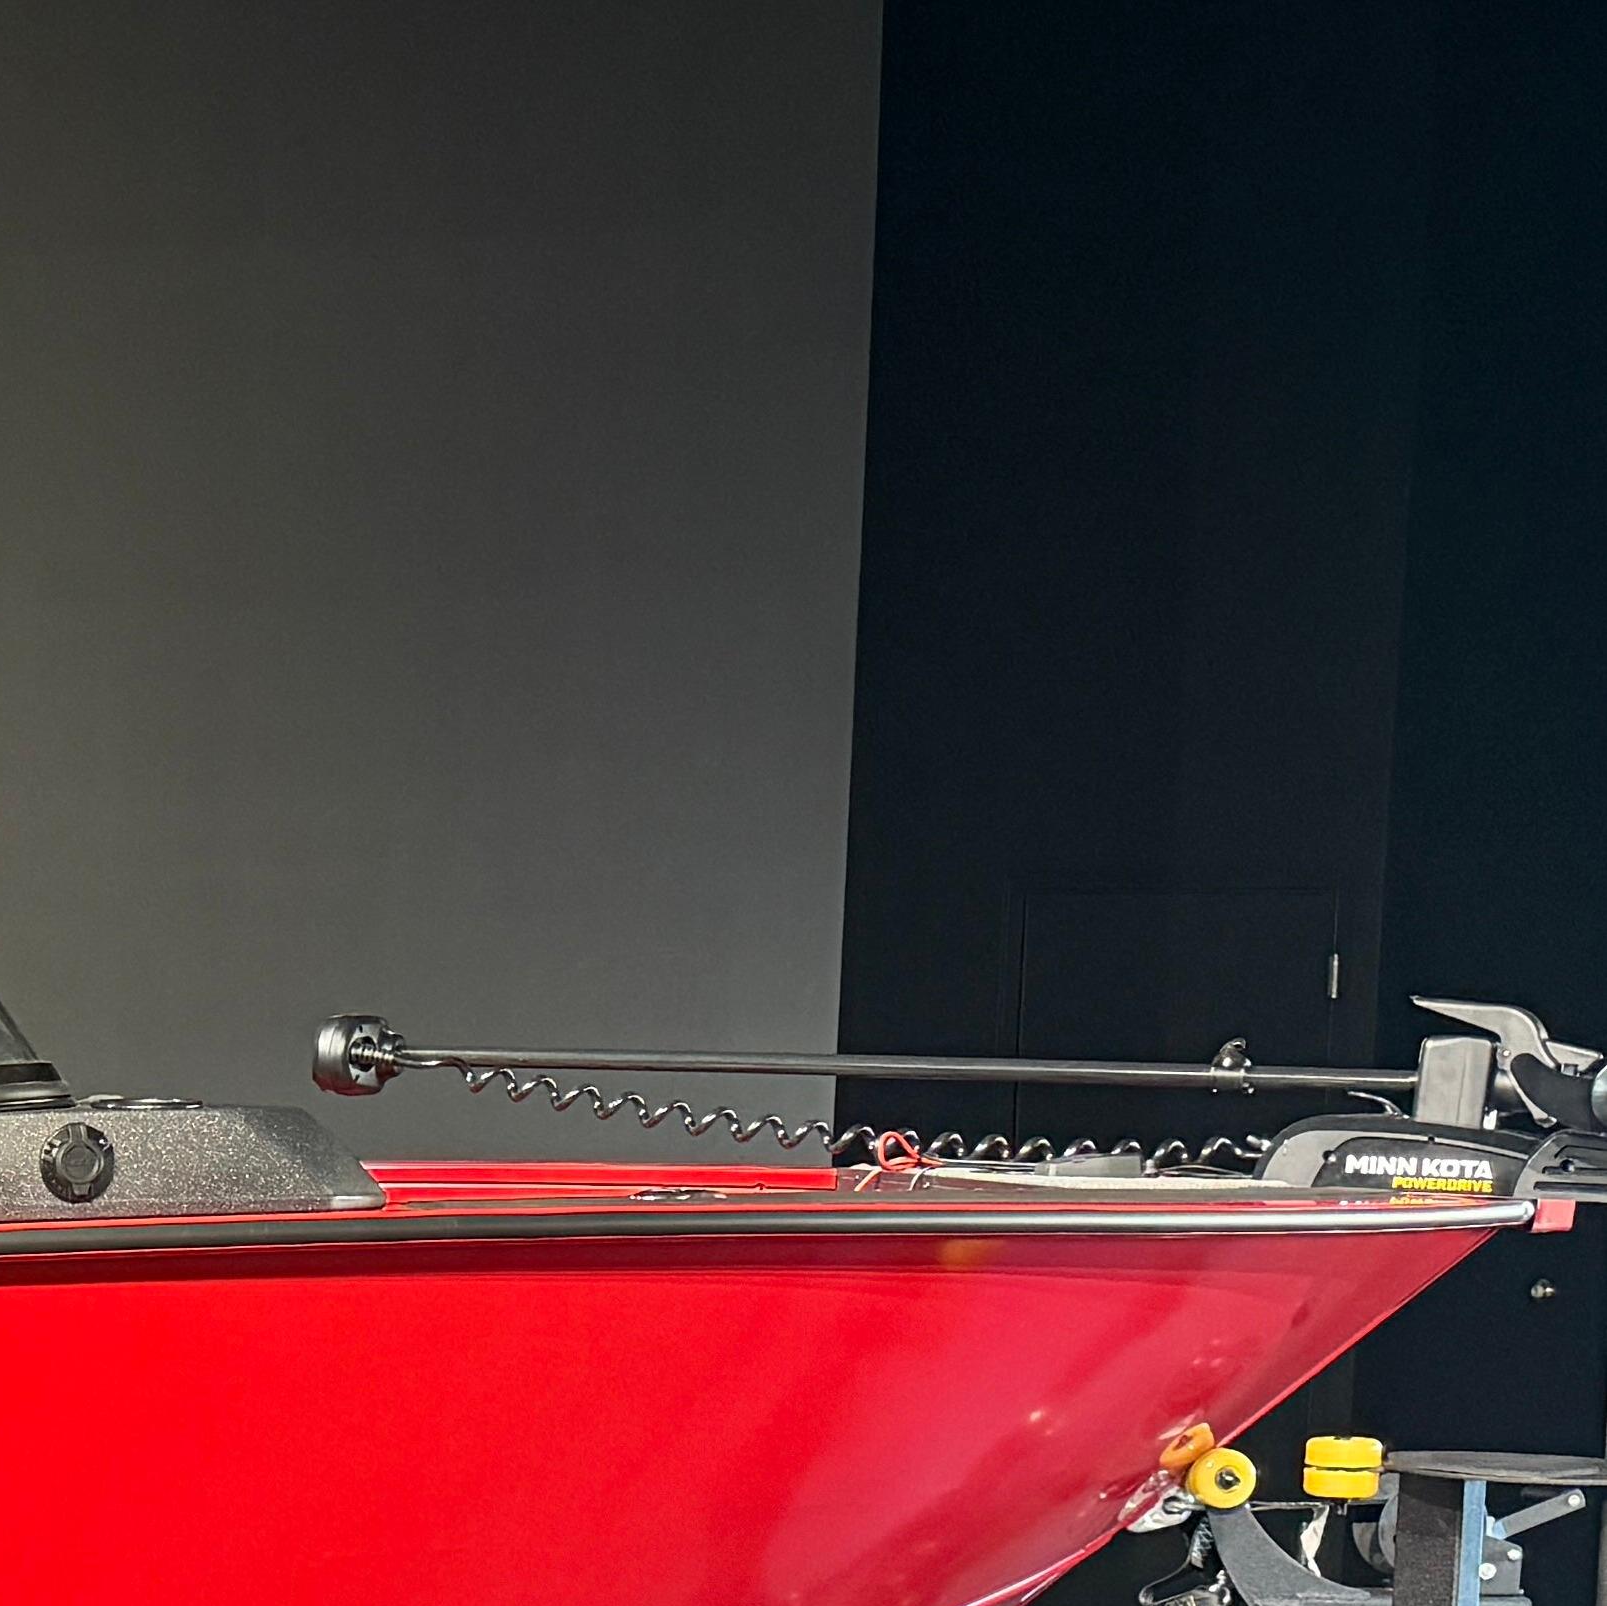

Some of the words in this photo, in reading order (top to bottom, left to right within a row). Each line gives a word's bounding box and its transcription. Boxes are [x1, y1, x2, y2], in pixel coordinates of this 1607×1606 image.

[1344, 1154, 1418, 1176] MINN
[1421, 1157, 1493, 1180] KOTA
[1391, 1176, 1493, 1193] POWERDRIVE
